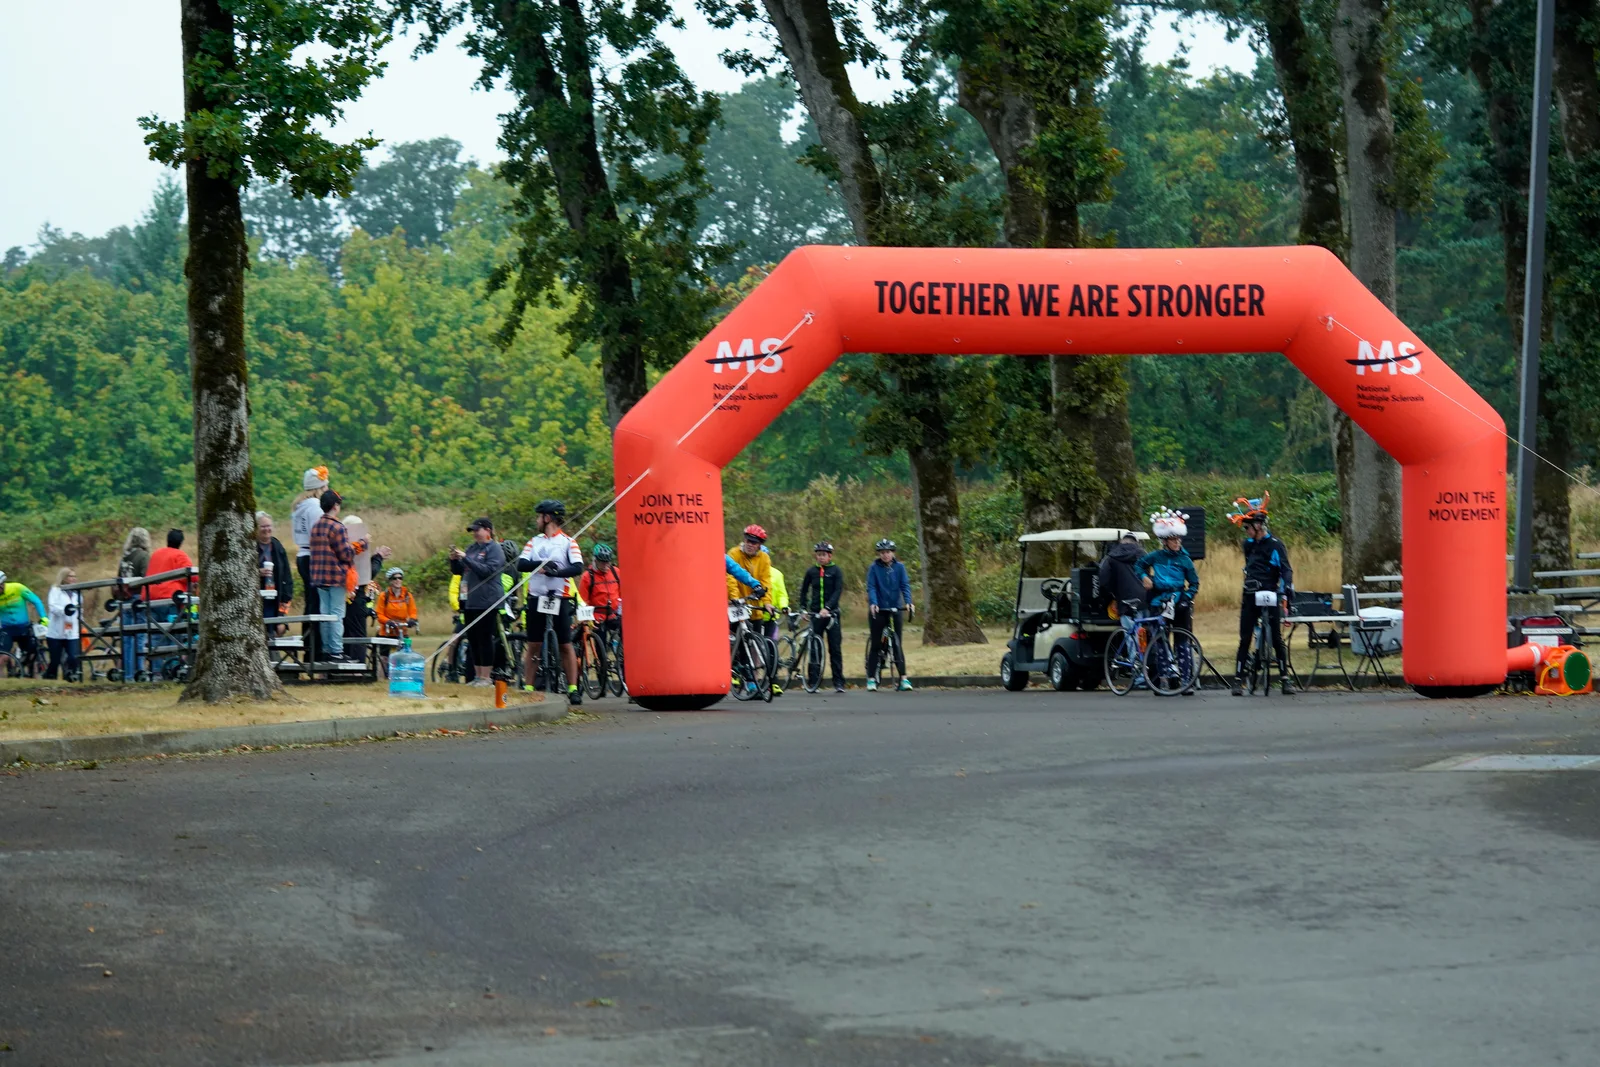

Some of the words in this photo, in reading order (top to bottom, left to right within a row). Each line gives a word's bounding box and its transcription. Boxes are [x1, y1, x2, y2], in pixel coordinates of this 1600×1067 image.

[874, 281, 1010, 316] TOGETHER
[1019, 283, 1060, 316] WE
[1068, 284, 1119, 317] ARE
[1128, 284, 1265, 317] STRONGER
[713, 338, 783, 373] MS
[1356, 340, 1421, 375] MS
[1357, 394, 1389, 402] Multiple
[1357, 402, 1384, 412] Society
[640, 494, 672, 507] JOIN
[677, 494, 703, 506] THE
[1436, 492, 1469, 504] JOIN
[1473, 491, 1496, 503] THE
[634, 512, 709, 525] MOVEMENT
[1429, 508, 1500, 521] MOVEMENT
